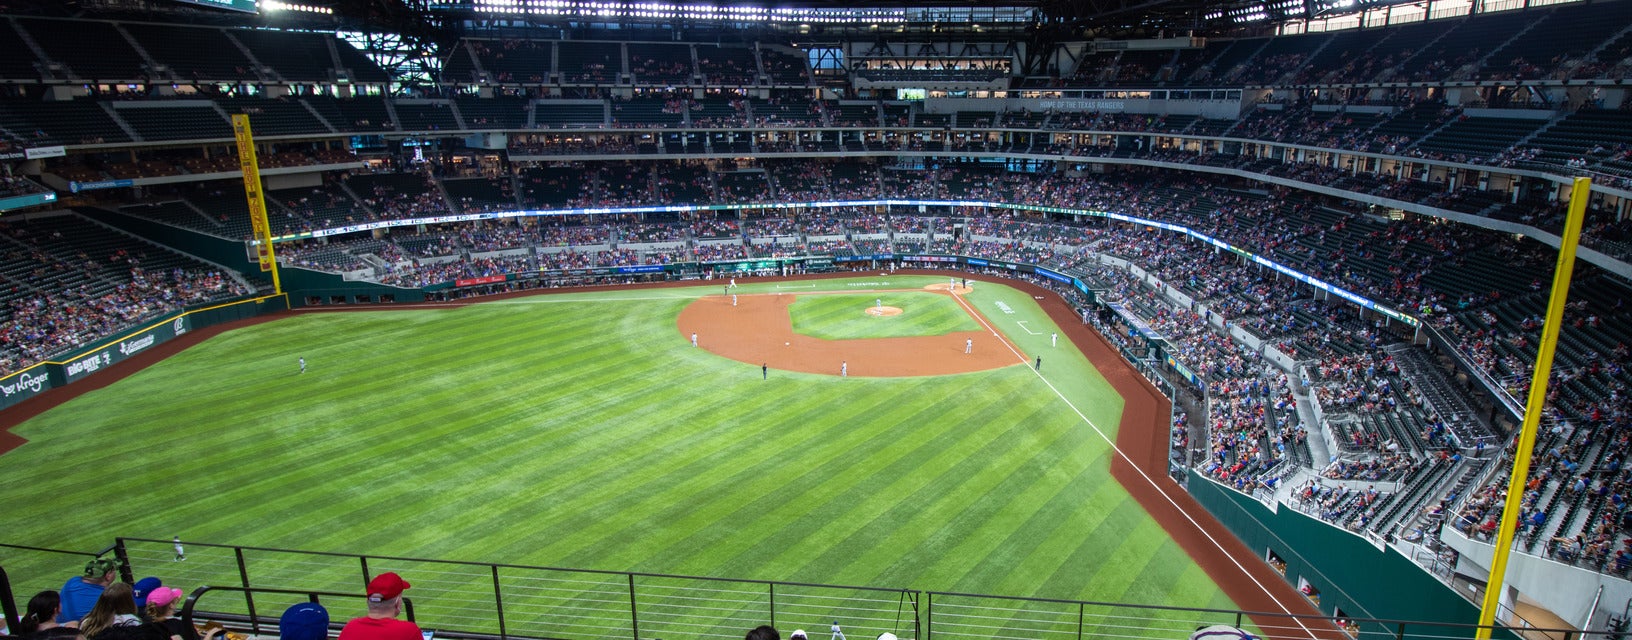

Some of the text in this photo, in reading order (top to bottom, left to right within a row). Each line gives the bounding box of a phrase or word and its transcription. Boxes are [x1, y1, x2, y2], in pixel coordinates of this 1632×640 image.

[1040, 101, 1125, 109] HOME OF THE TEXAS RANGERS
[16, 372, 49, 392] Kroger
[134, 589, 141, 597] T
